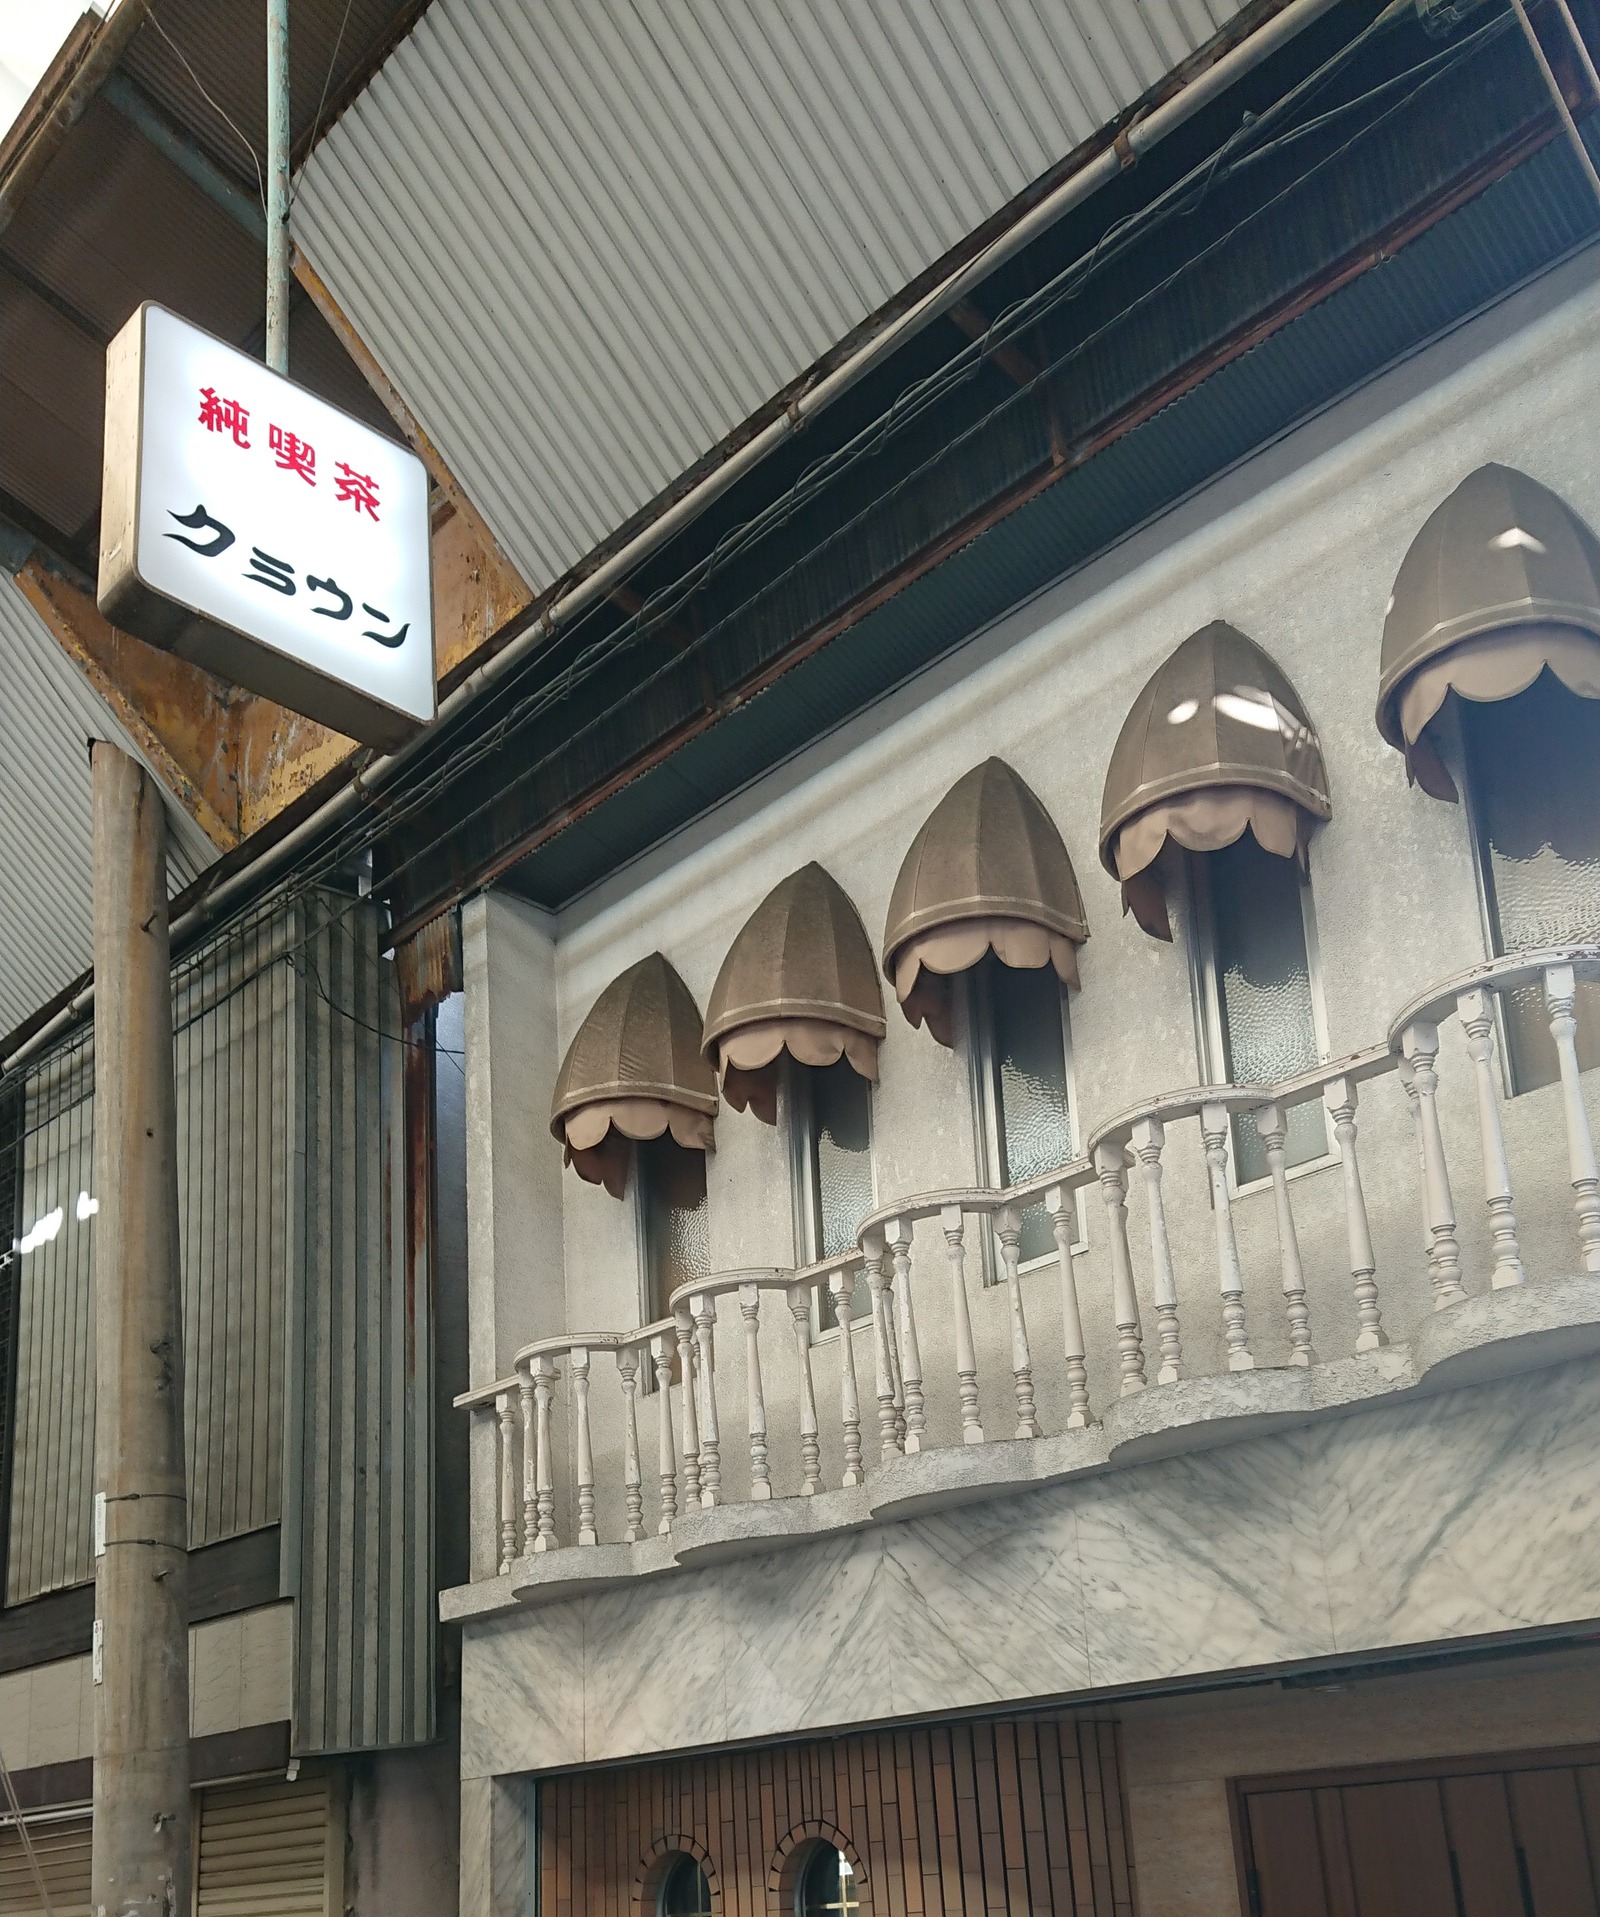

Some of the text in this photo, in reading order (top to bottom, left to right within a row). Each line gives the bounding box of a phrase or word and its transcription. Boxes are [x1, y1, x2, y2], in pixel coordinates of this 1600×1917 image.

[198, 387, 381, 522] 純喫茶
[162, 504, 411, 648] クラウン
